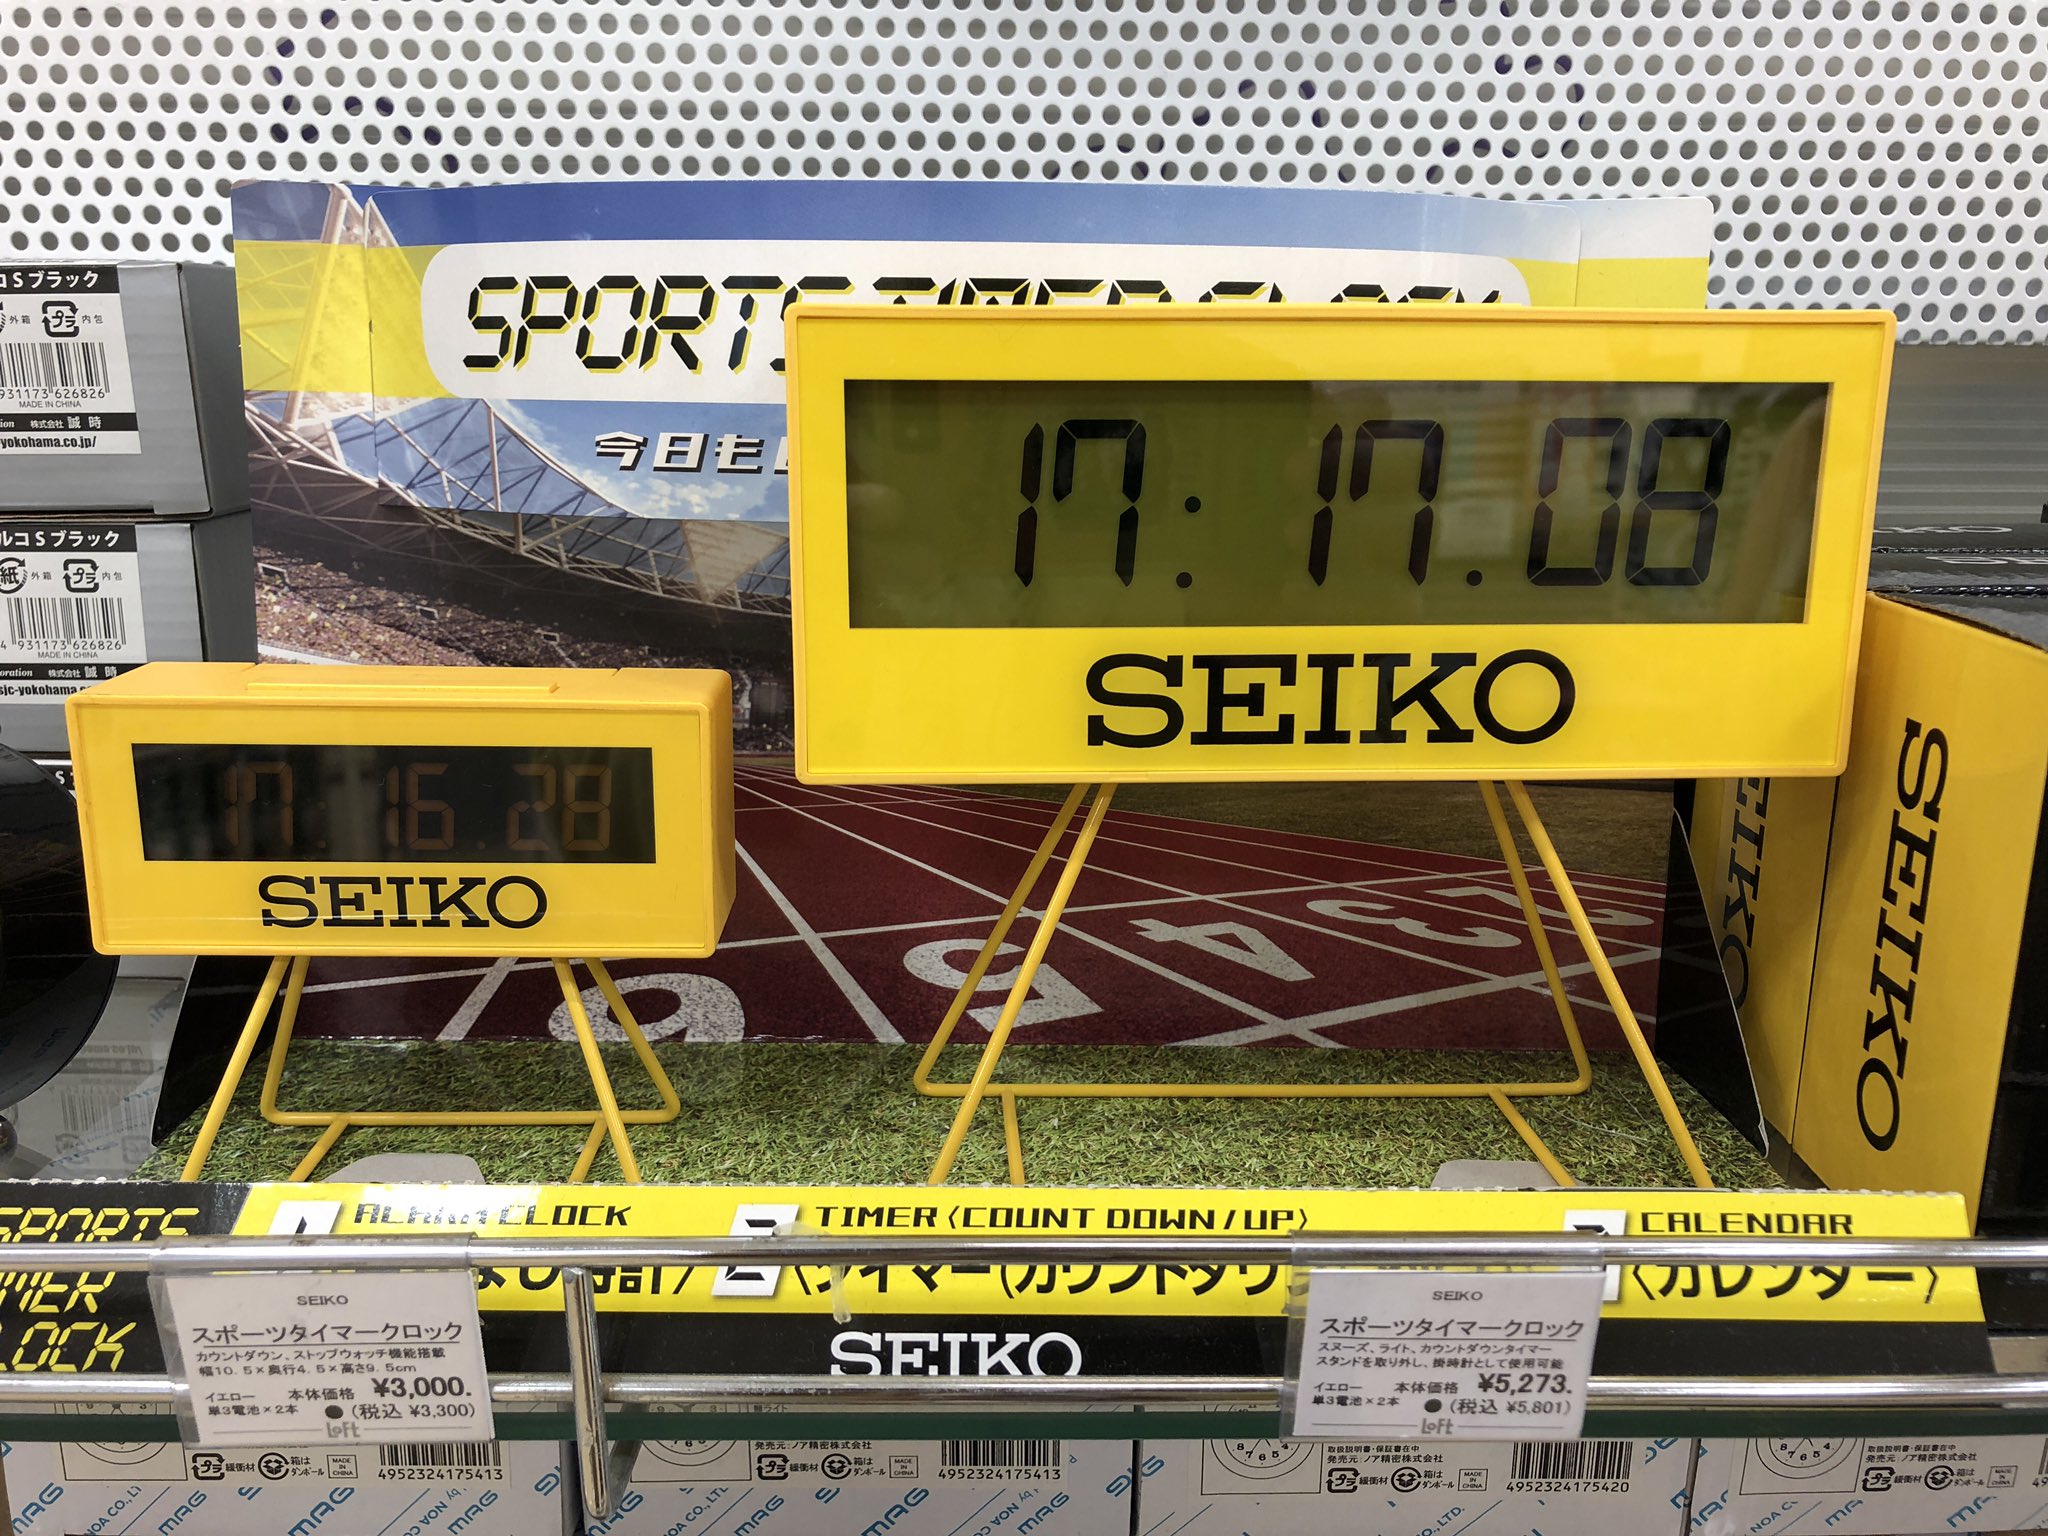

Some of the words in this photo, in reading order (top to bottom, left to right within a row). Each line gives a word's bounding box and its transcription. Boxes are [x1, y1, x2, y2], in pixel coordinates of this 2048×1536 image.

[55, 388, 105, 399] 626826
[31, 571, 52, 581] 外箱
[102, 571, 123, 581] 内包
[17, 640, 67, 651] 931173
[73, 640, 122, 651] 626826
[1085, 649, 1576, 748] SEIKO
[258, 874, 548, 929] SEIKO
[1857, 718, 1949, 1152] SEIKO
[499, 1204, 631, 1226] CLOCK
[816, 1206, 938, 1229] TIMER
[1641, 1212, 1853, 1235] CALENDAR
[297, 1295, 349, 1306] SEIKO
[1432, 1291, 1483, 1301] SEIKO
[1319, 1316, 1584, 1337] スポーツタイマークロック
[192, 1322, 463, 1344] スポーツタイマークロック
[829, 1331, 1083, 1376] SEIKO
[1313, 1382, 1362, 1392] イエロー
[1394, 1381, 1459, 1394] 本体価格
[205, 1392, 256, 1402] イエロー
[288, 1387, 355, 1401] 本体価格
[1312, 1395, 1400, 1406] 単3電池×2本
[208, 1404, 298, 1416] 単3電池×2本
[378, 1468, 503, 1480] 4952324175413
[938, 1468, 1061, 1480] 4952324175413
[1506, 1481, 1630, 1493] 4952324175420
